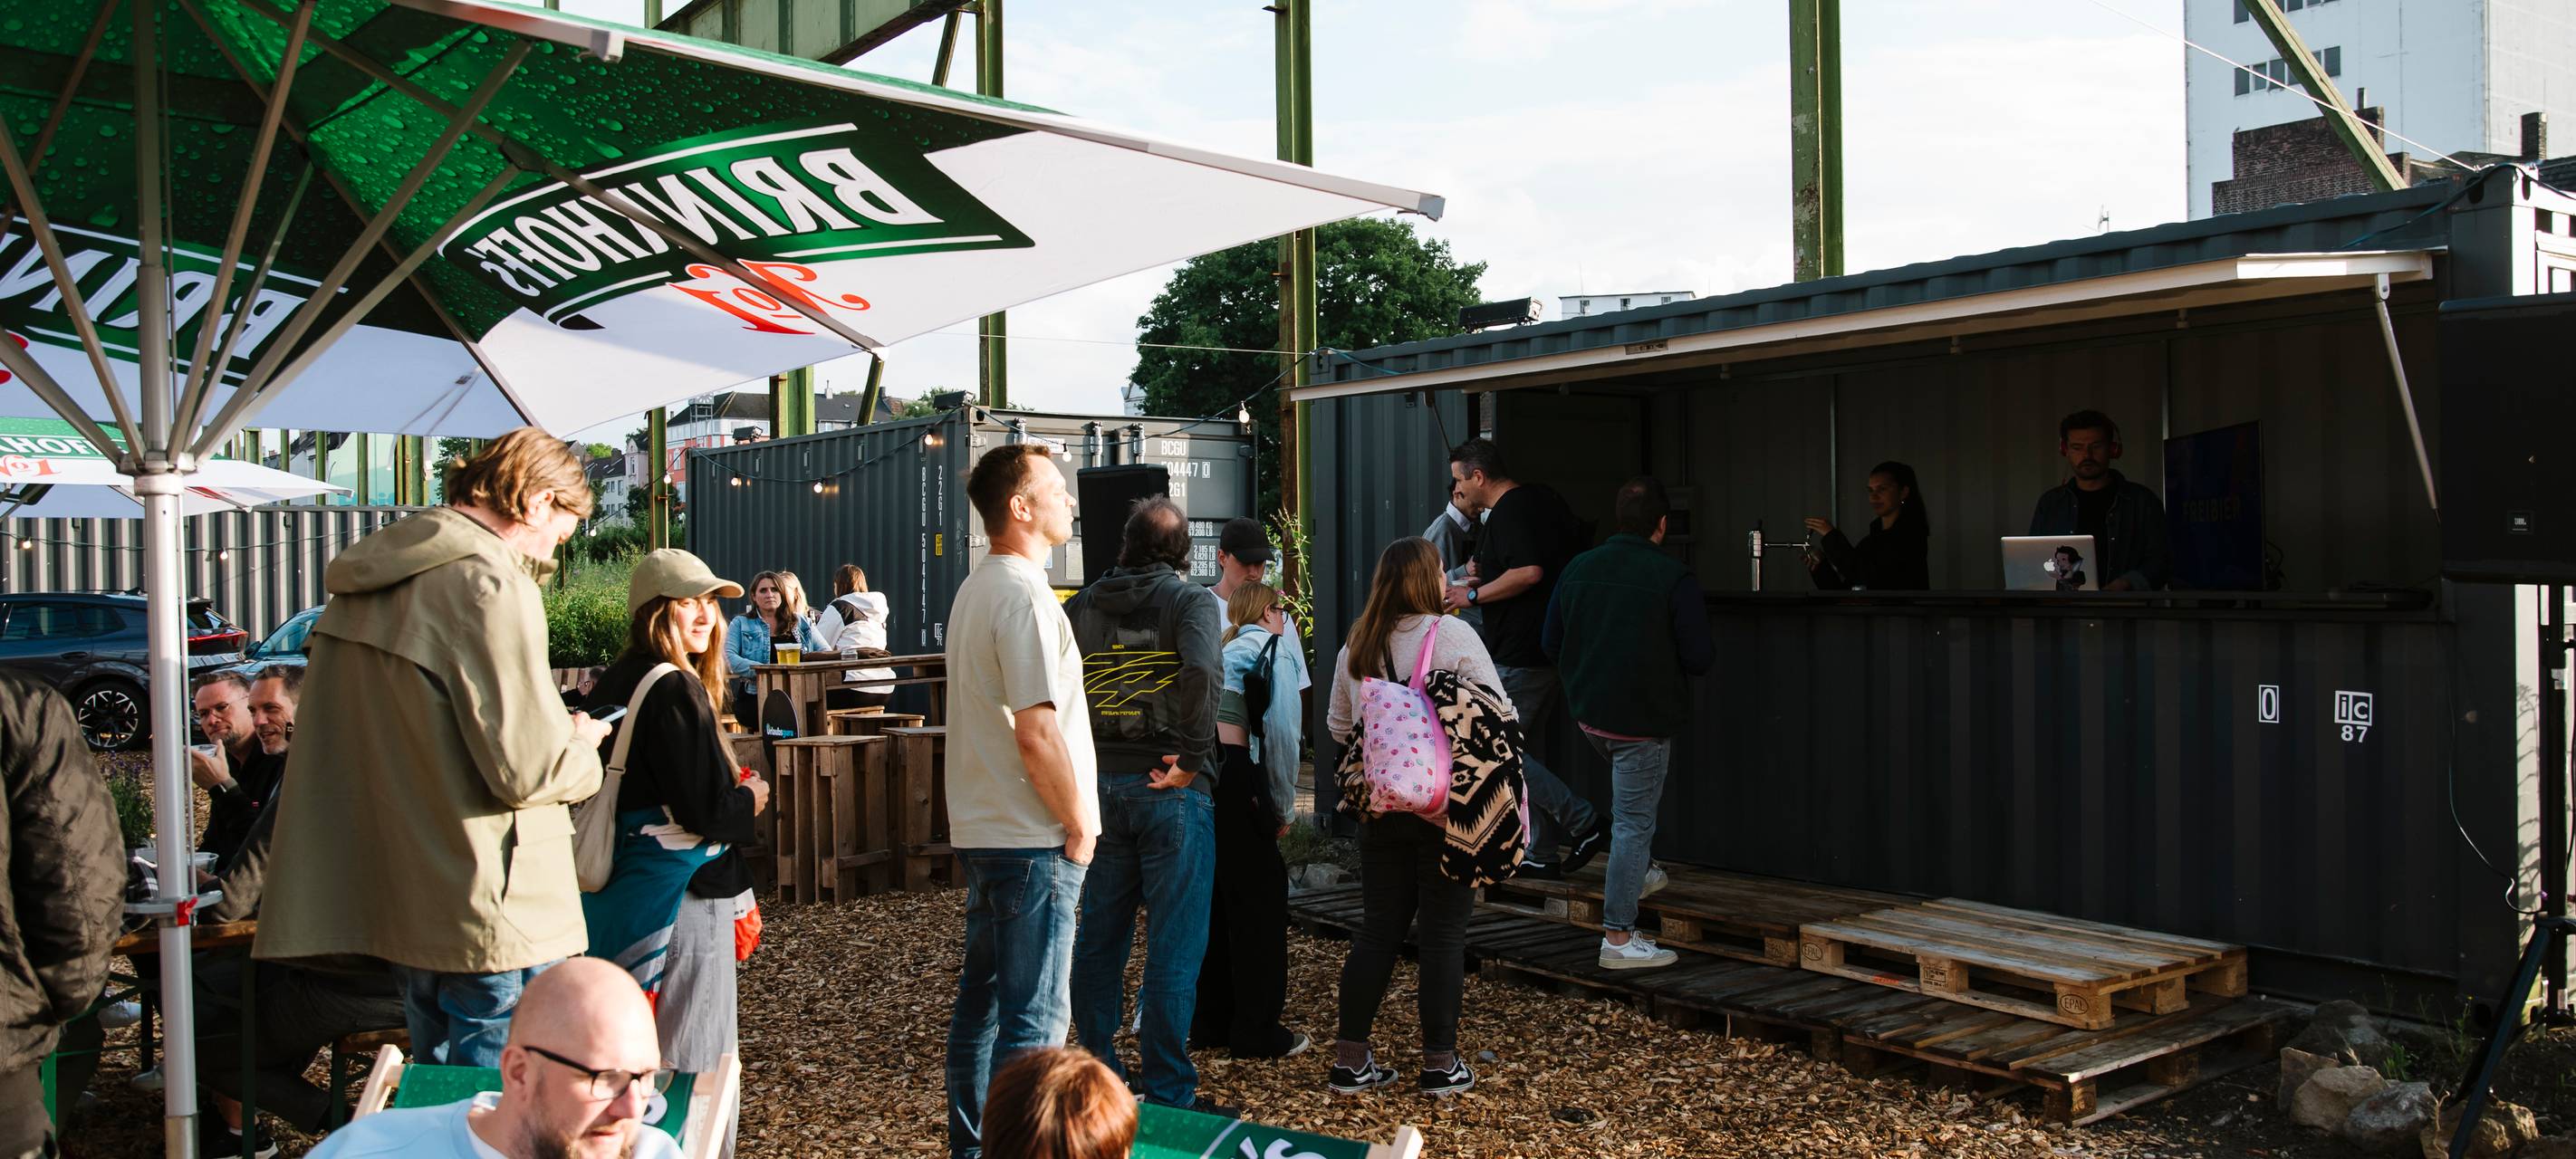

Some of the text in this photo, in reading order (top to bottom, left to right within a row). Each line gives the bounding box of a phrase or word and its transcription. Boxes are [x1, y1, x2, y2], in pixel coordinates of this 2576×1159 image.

[1161, 440, 1187, 456] BCGU
[1161, 461, 1198, 477] 04447
[1168, 482, 1186, 497] 2G1
[2514, 517, 2527, 525] JBL
[2338, 694, 2370, 723] ic
[2341, 724, 2368, 742] 87
[1803, 944, 1821, 959] EPAL
[2063, 997, 2087, 1012] EPAL
